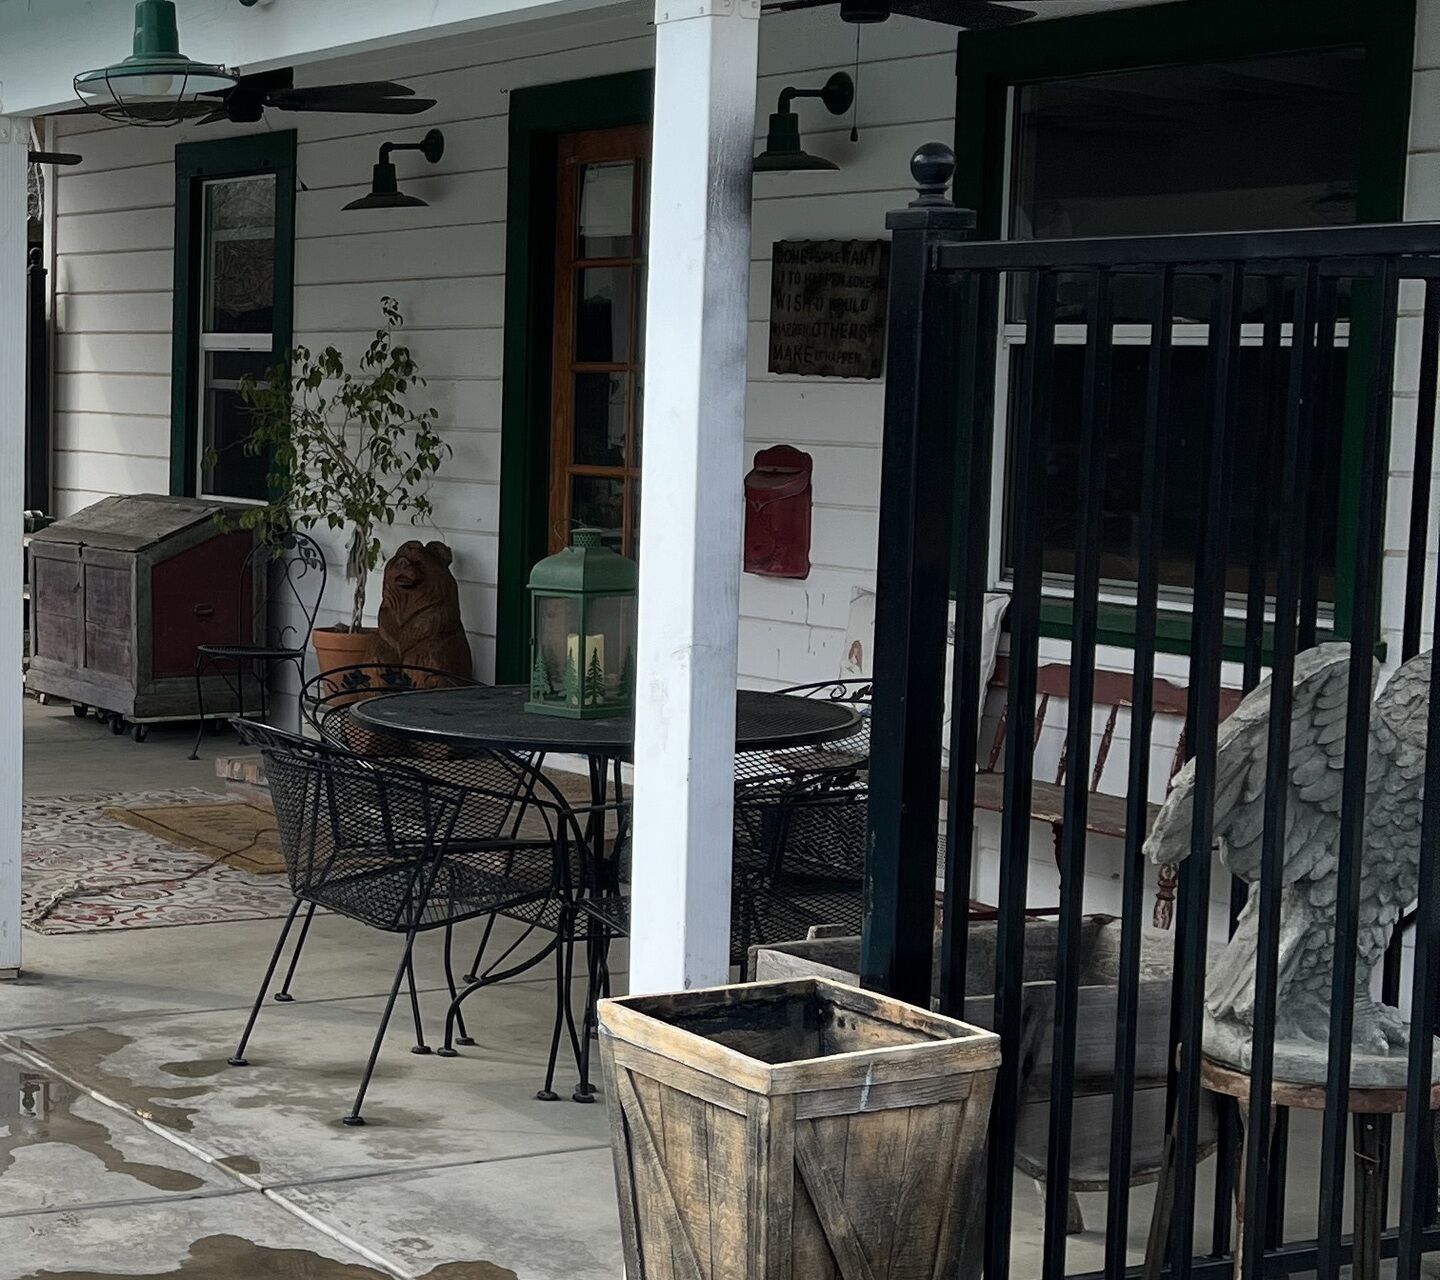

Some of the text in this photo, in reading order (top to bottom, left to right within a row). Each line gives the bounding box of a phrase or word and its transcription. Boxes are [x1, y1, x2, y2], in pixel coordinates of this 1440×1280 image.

[789, 271, 802, 285] TO
[812, 322, 868, 341] OTHERS
[772, 344, 815, 364] MAKE
